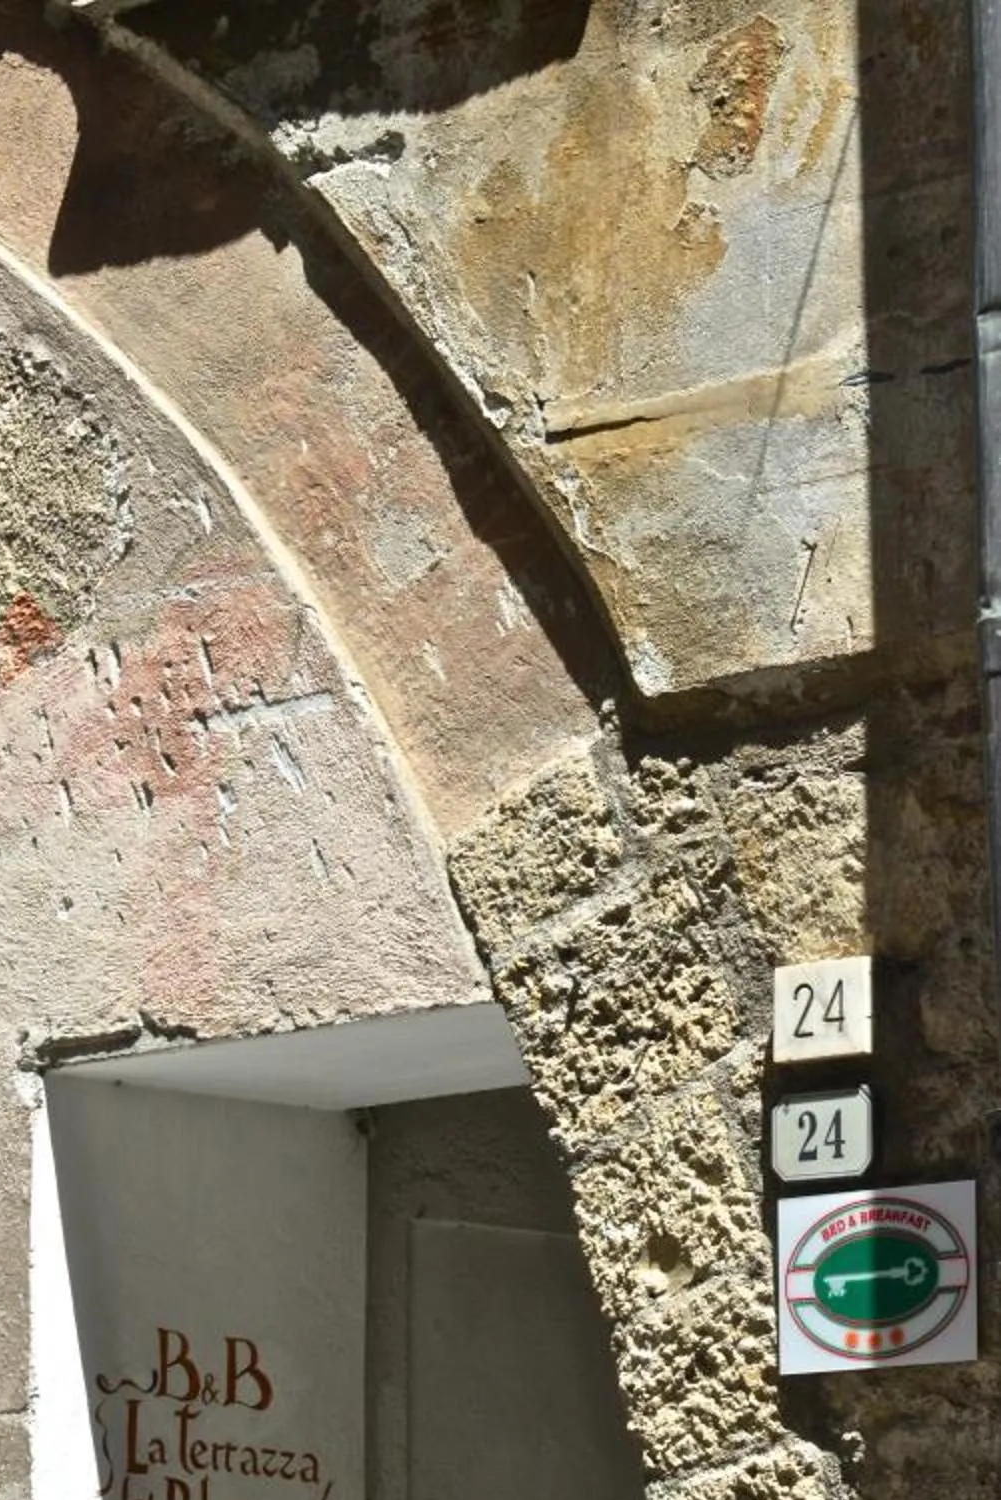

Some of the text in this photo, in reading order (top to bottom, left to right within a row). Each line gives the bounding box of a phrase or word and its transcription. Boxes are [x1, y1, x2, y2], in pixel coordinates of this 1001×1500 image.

[793, 978, 847, 1040] 24
[798, 1108, 847, 1162] 24
[821, 1218, 847, 1243] BED
[860, 1207, 932, 1232] BREAKFAST
[154, 1327, 274, 1411] B&B
[125, 1400, 319, 1485] La Terrazza
